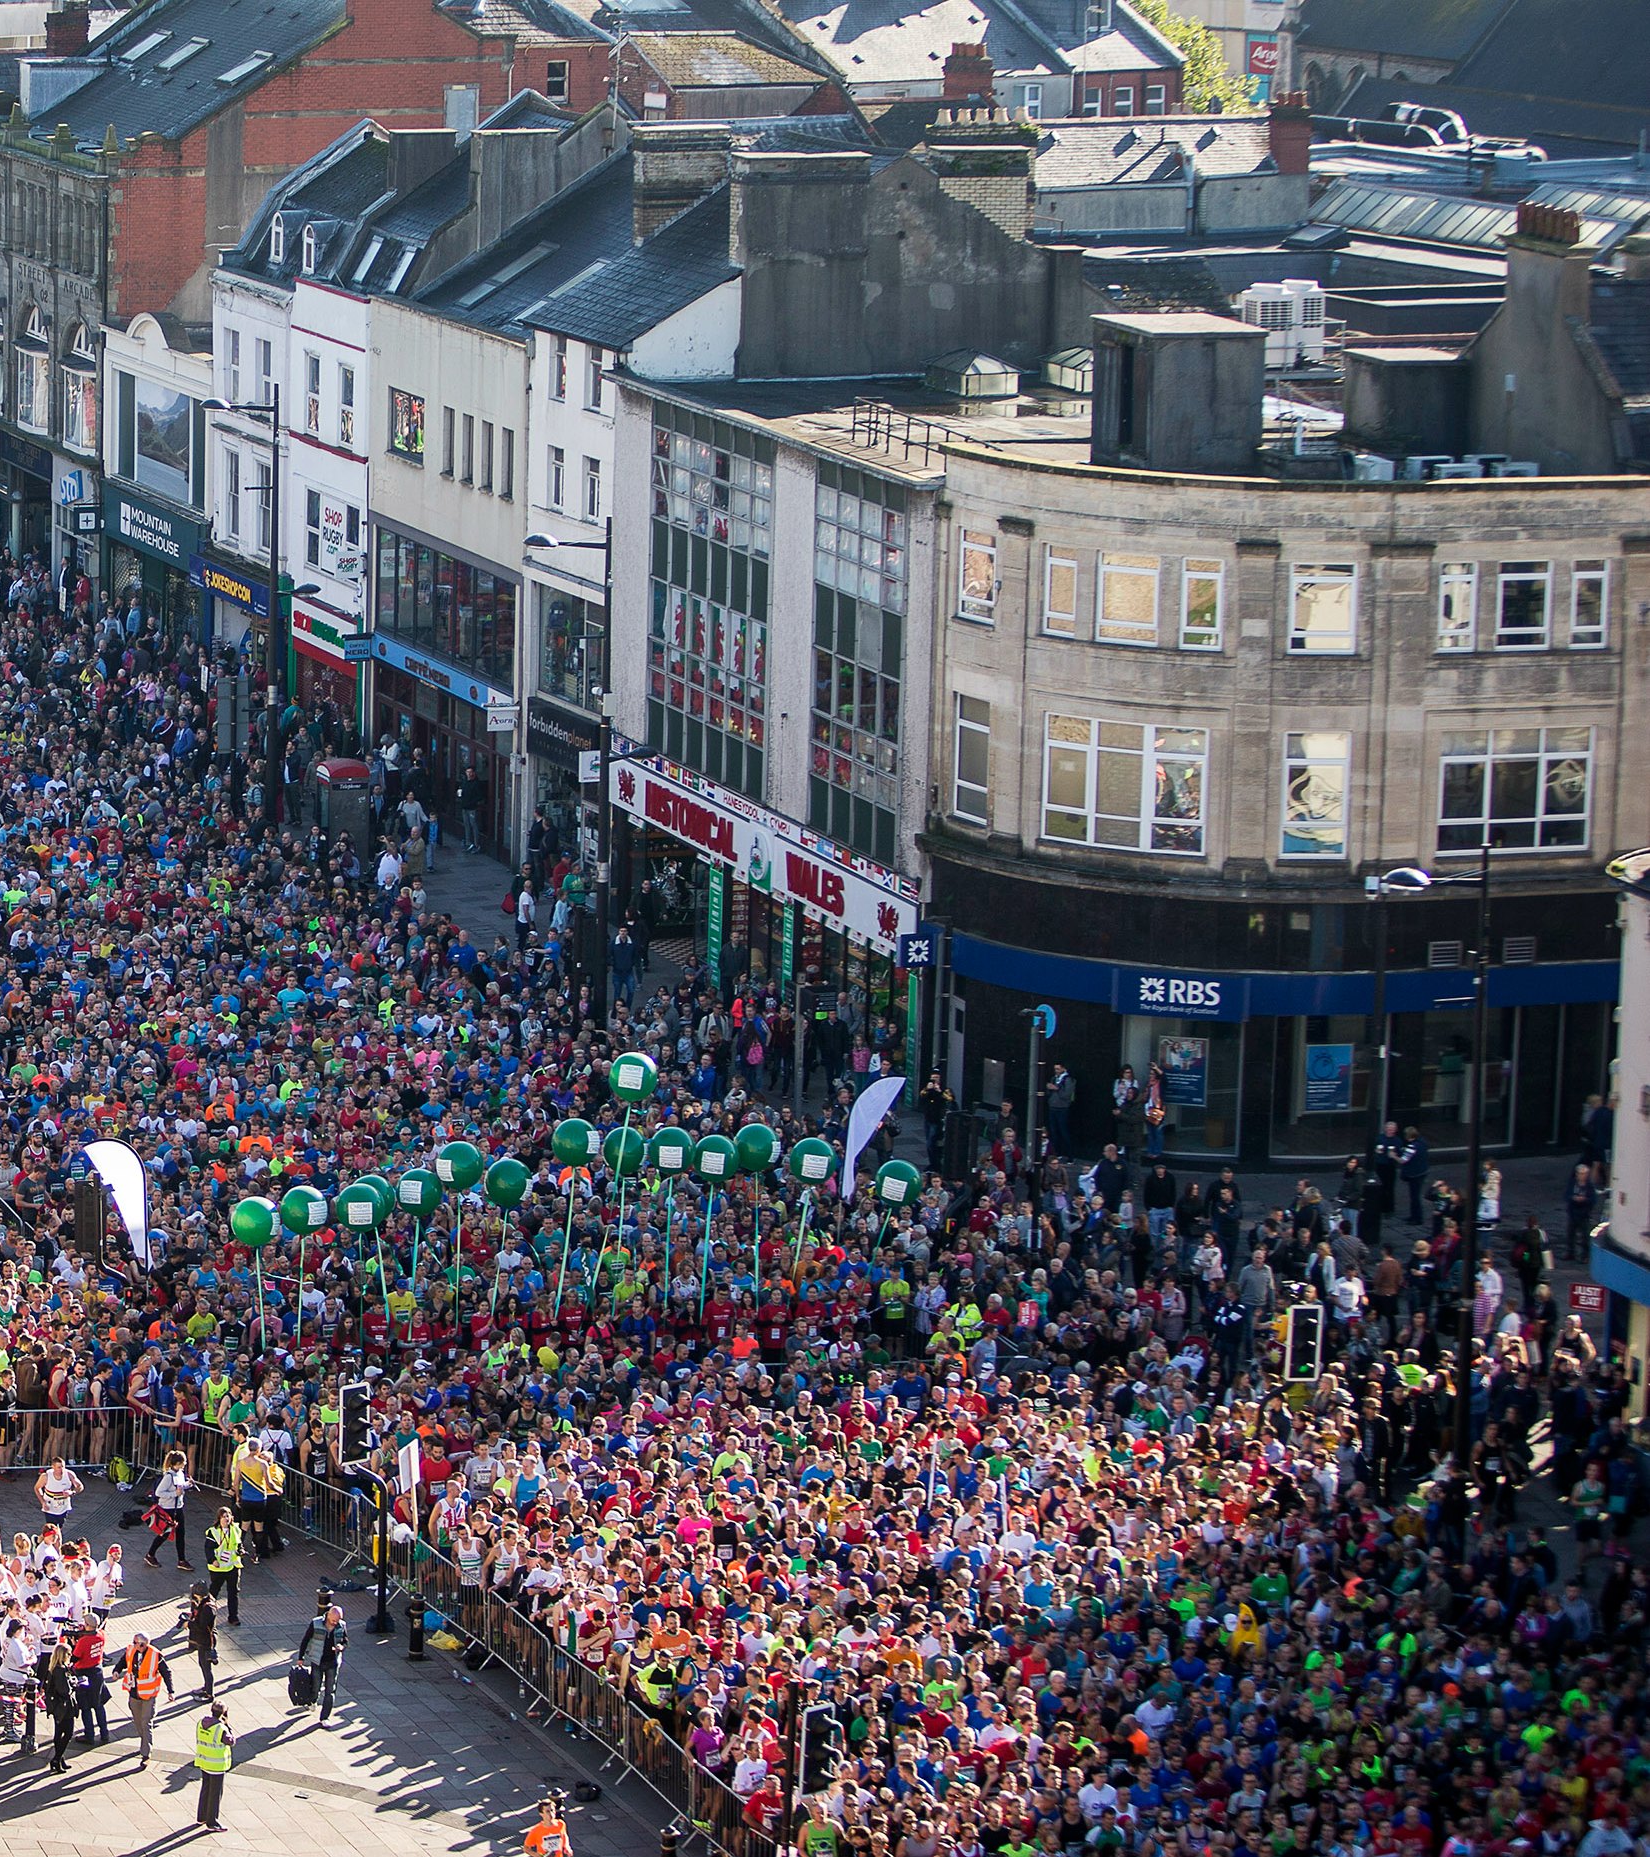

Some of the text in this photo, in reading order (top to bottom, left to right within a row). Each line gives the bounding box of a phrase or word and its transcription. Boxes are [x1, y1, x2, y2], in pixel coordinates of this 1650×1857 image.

[18, 262, 47, 285] STREET
[63, 279, 95, 301] ARCADE
[131, 506, 172, 537] MOUNTAIN
[324, 506, 343, 528] SHOP
[130, 523, 180, 558] WAREHOUSE
[322, 526, 344, 547] RUGBY
[489, 716, 514, 726] Acorn
[723, 792, 790, 835] HANESYDDOL CYMRU
[644, 779, 845, 918] HISTORICAL WALES
[1168, 979, 1221, 1006] RBS
[1151, 1004, 1169, 1012] Royal
[1185, 1006, 1192, 1014] of
[1192, 1007, 1220, 1015] Scotland
[1573, 1286, 1603, 1296] JUST
[1579, 1296, 1603, 1306] EAT
